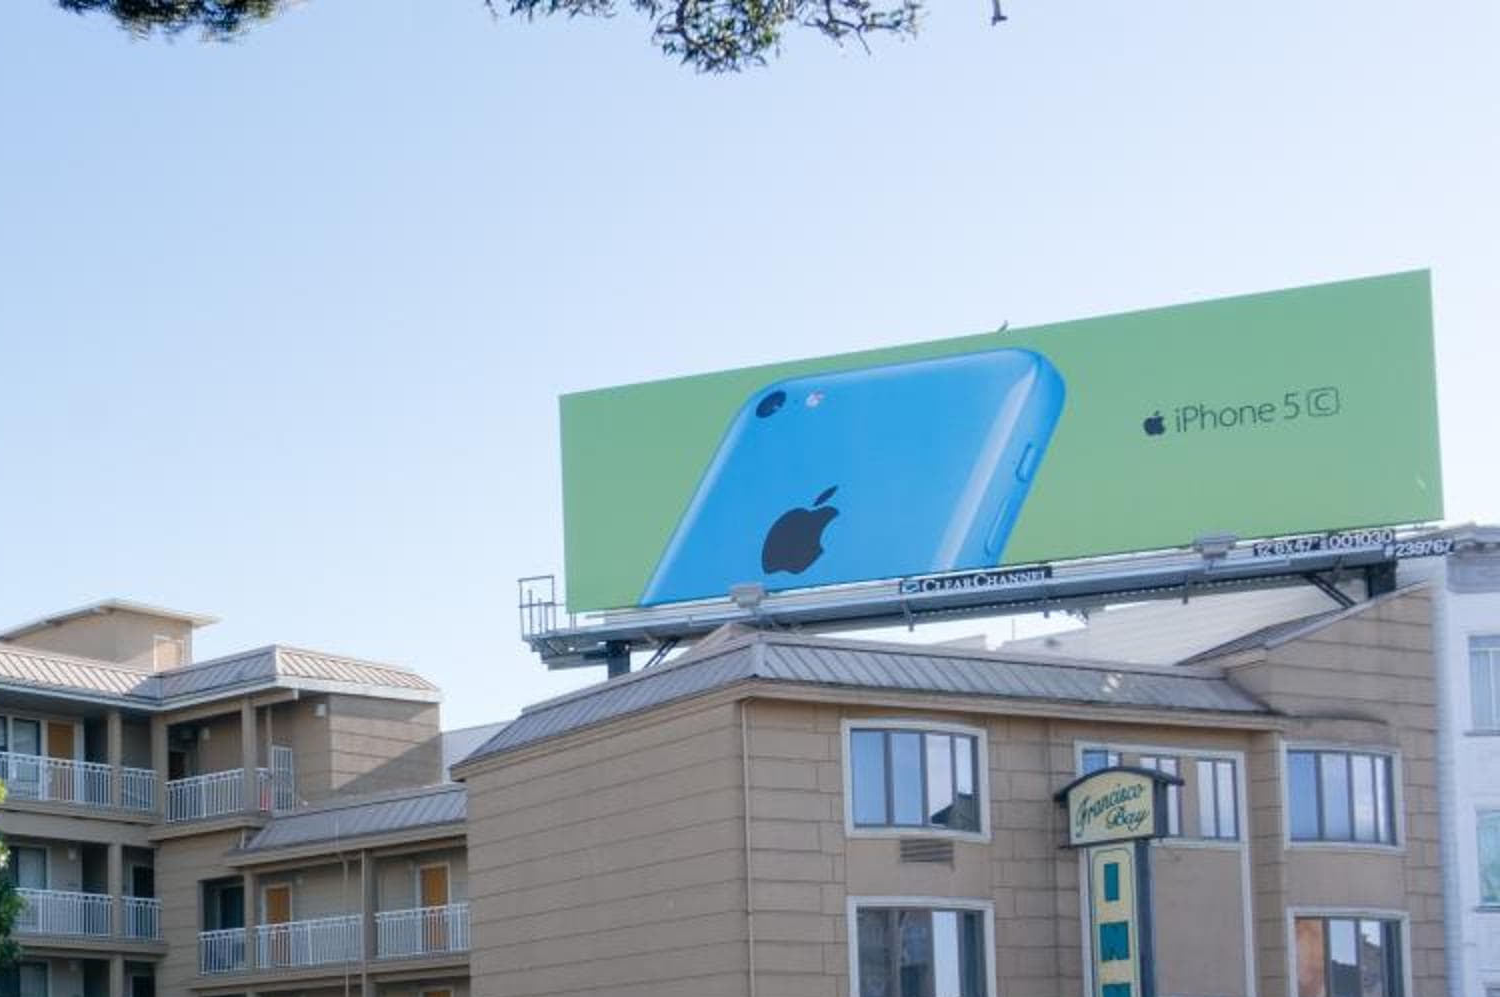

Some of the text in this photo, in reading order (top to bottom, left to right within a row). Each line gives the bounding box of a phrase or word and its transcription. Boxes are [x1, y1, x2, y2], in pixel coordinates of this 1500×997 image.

[1174, 402, 1277, 433] iPhone
[1074, 783, 1145, 838] Francisco
[1106, 804, 1151, 832] Bay
